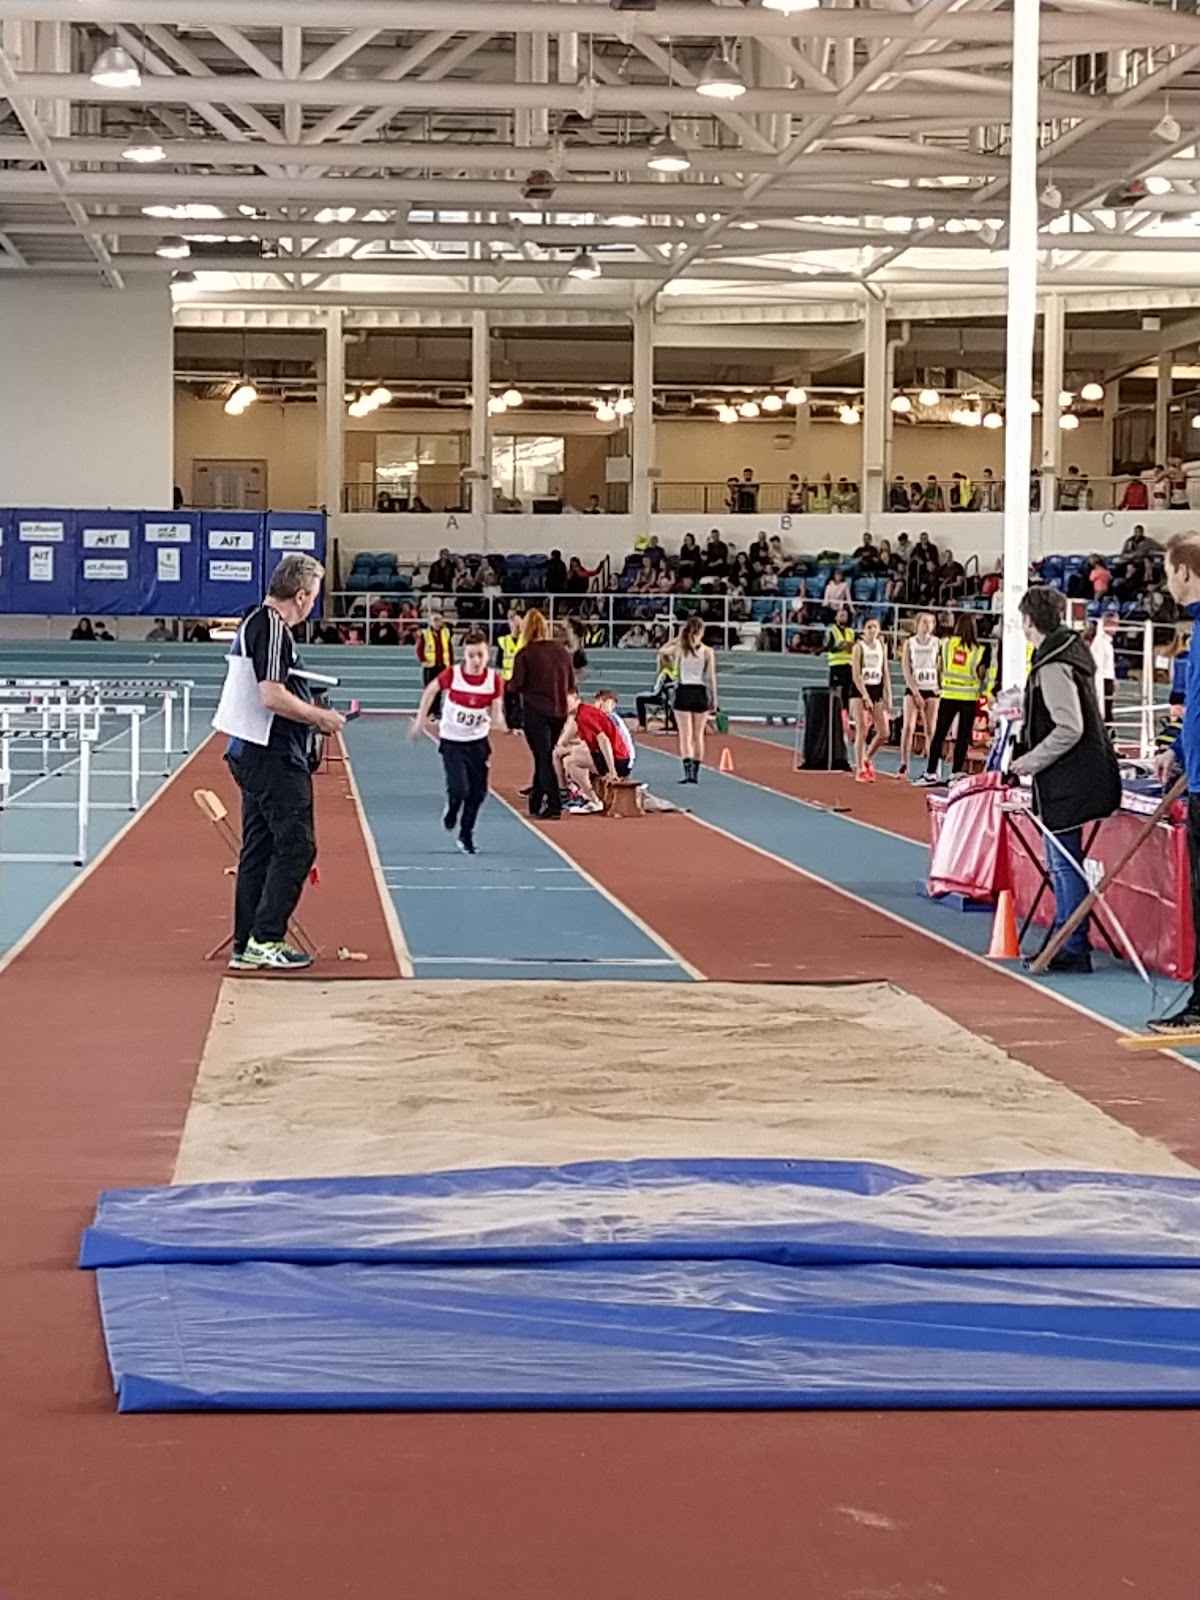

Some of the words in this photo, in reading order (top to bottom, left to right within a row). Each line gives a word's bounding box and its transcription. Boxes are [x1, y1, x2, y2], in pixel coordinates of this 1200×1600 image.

[446, 515, 459, 529] A
[781, 515, 793, 531] B
[1102, 511, 1115, 528] C
